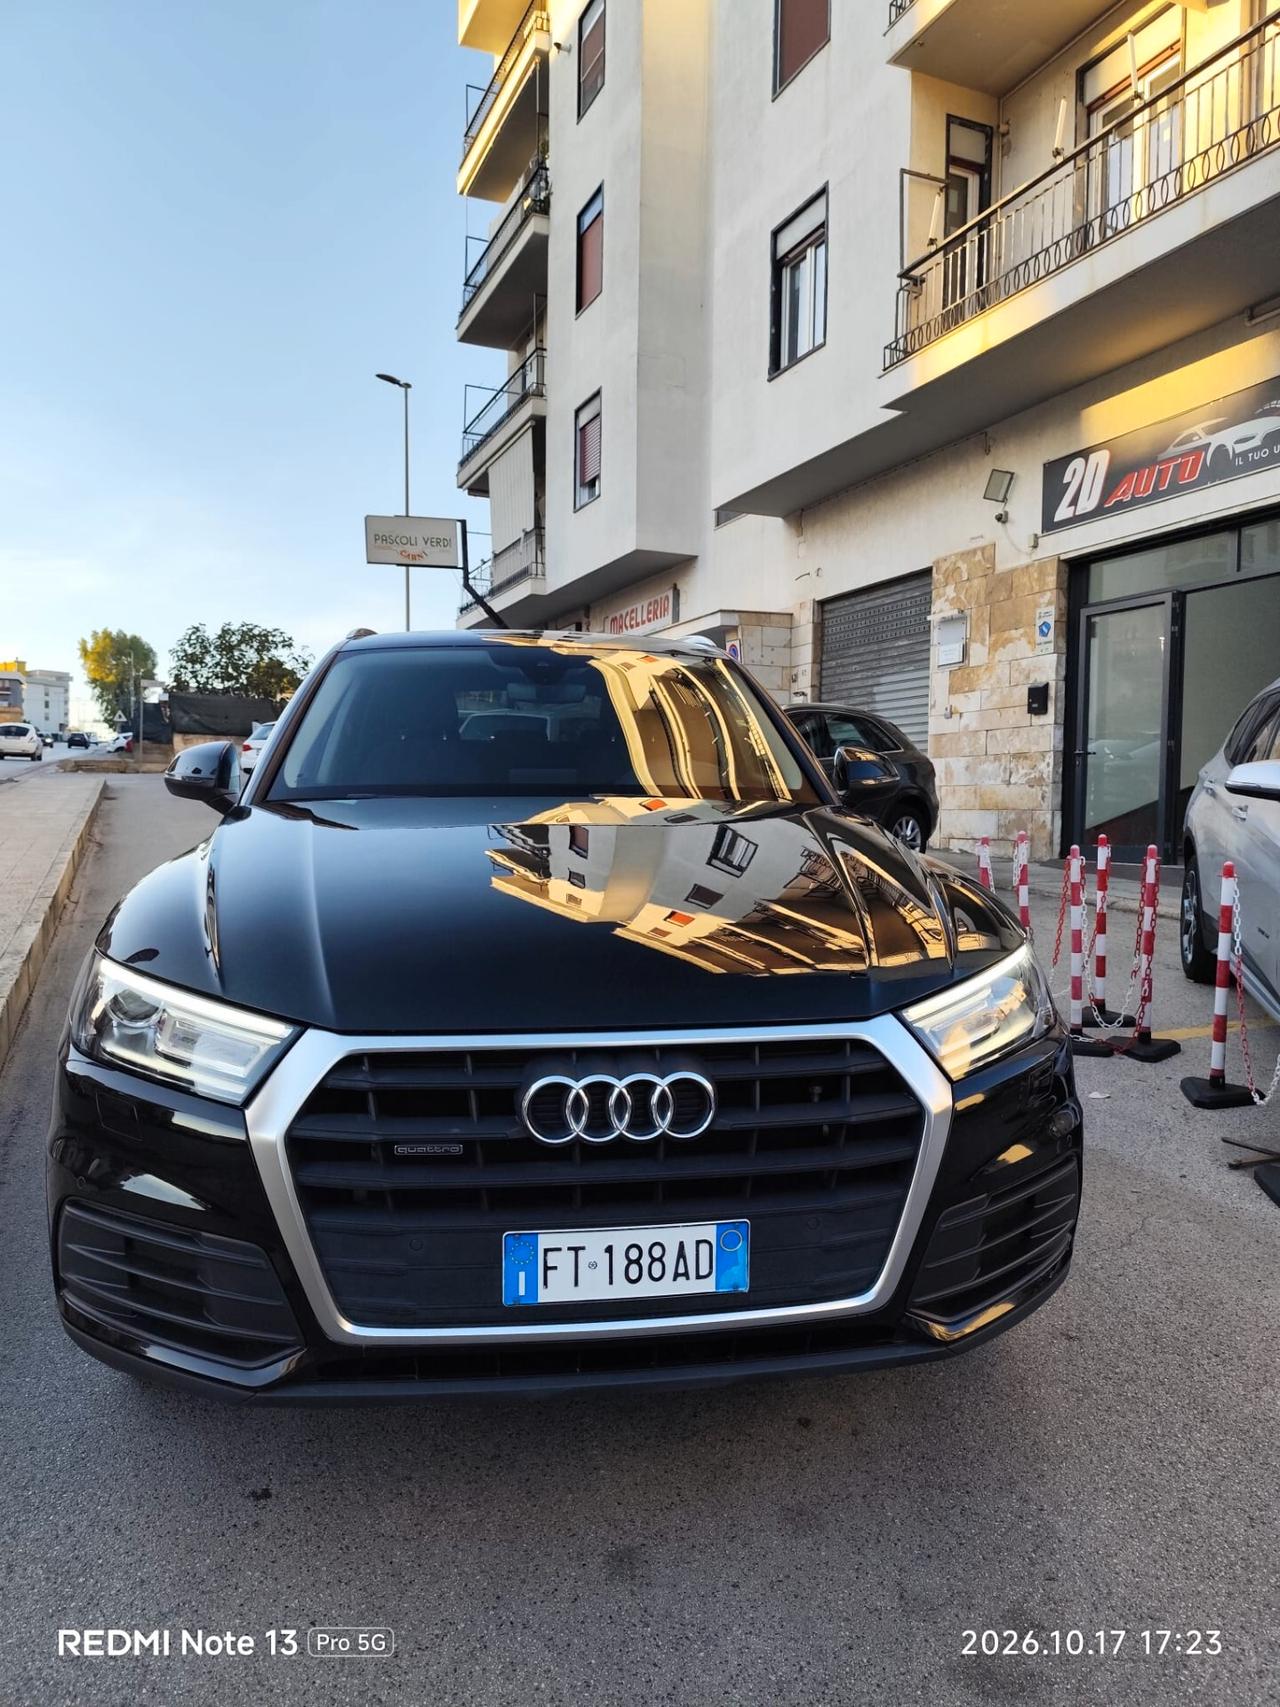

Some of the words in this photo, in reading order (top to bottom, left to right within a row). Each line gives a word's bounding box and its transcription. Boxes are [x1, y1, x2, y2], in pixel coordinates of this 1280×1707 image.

[1235, 456, 1244, 467] IL
[1248, 448, 1269, 462] TUO
[1054, 449, 1111, 522] 2D
[1104, 450, 1205, 508] AUTO
[374, 533, 418, 546] PASCOLI
[422, 536, 452, 548] VERDI
[610, 594, 670, 635] MACELLERIA
[397, 1144, 459, 1154] quattro
